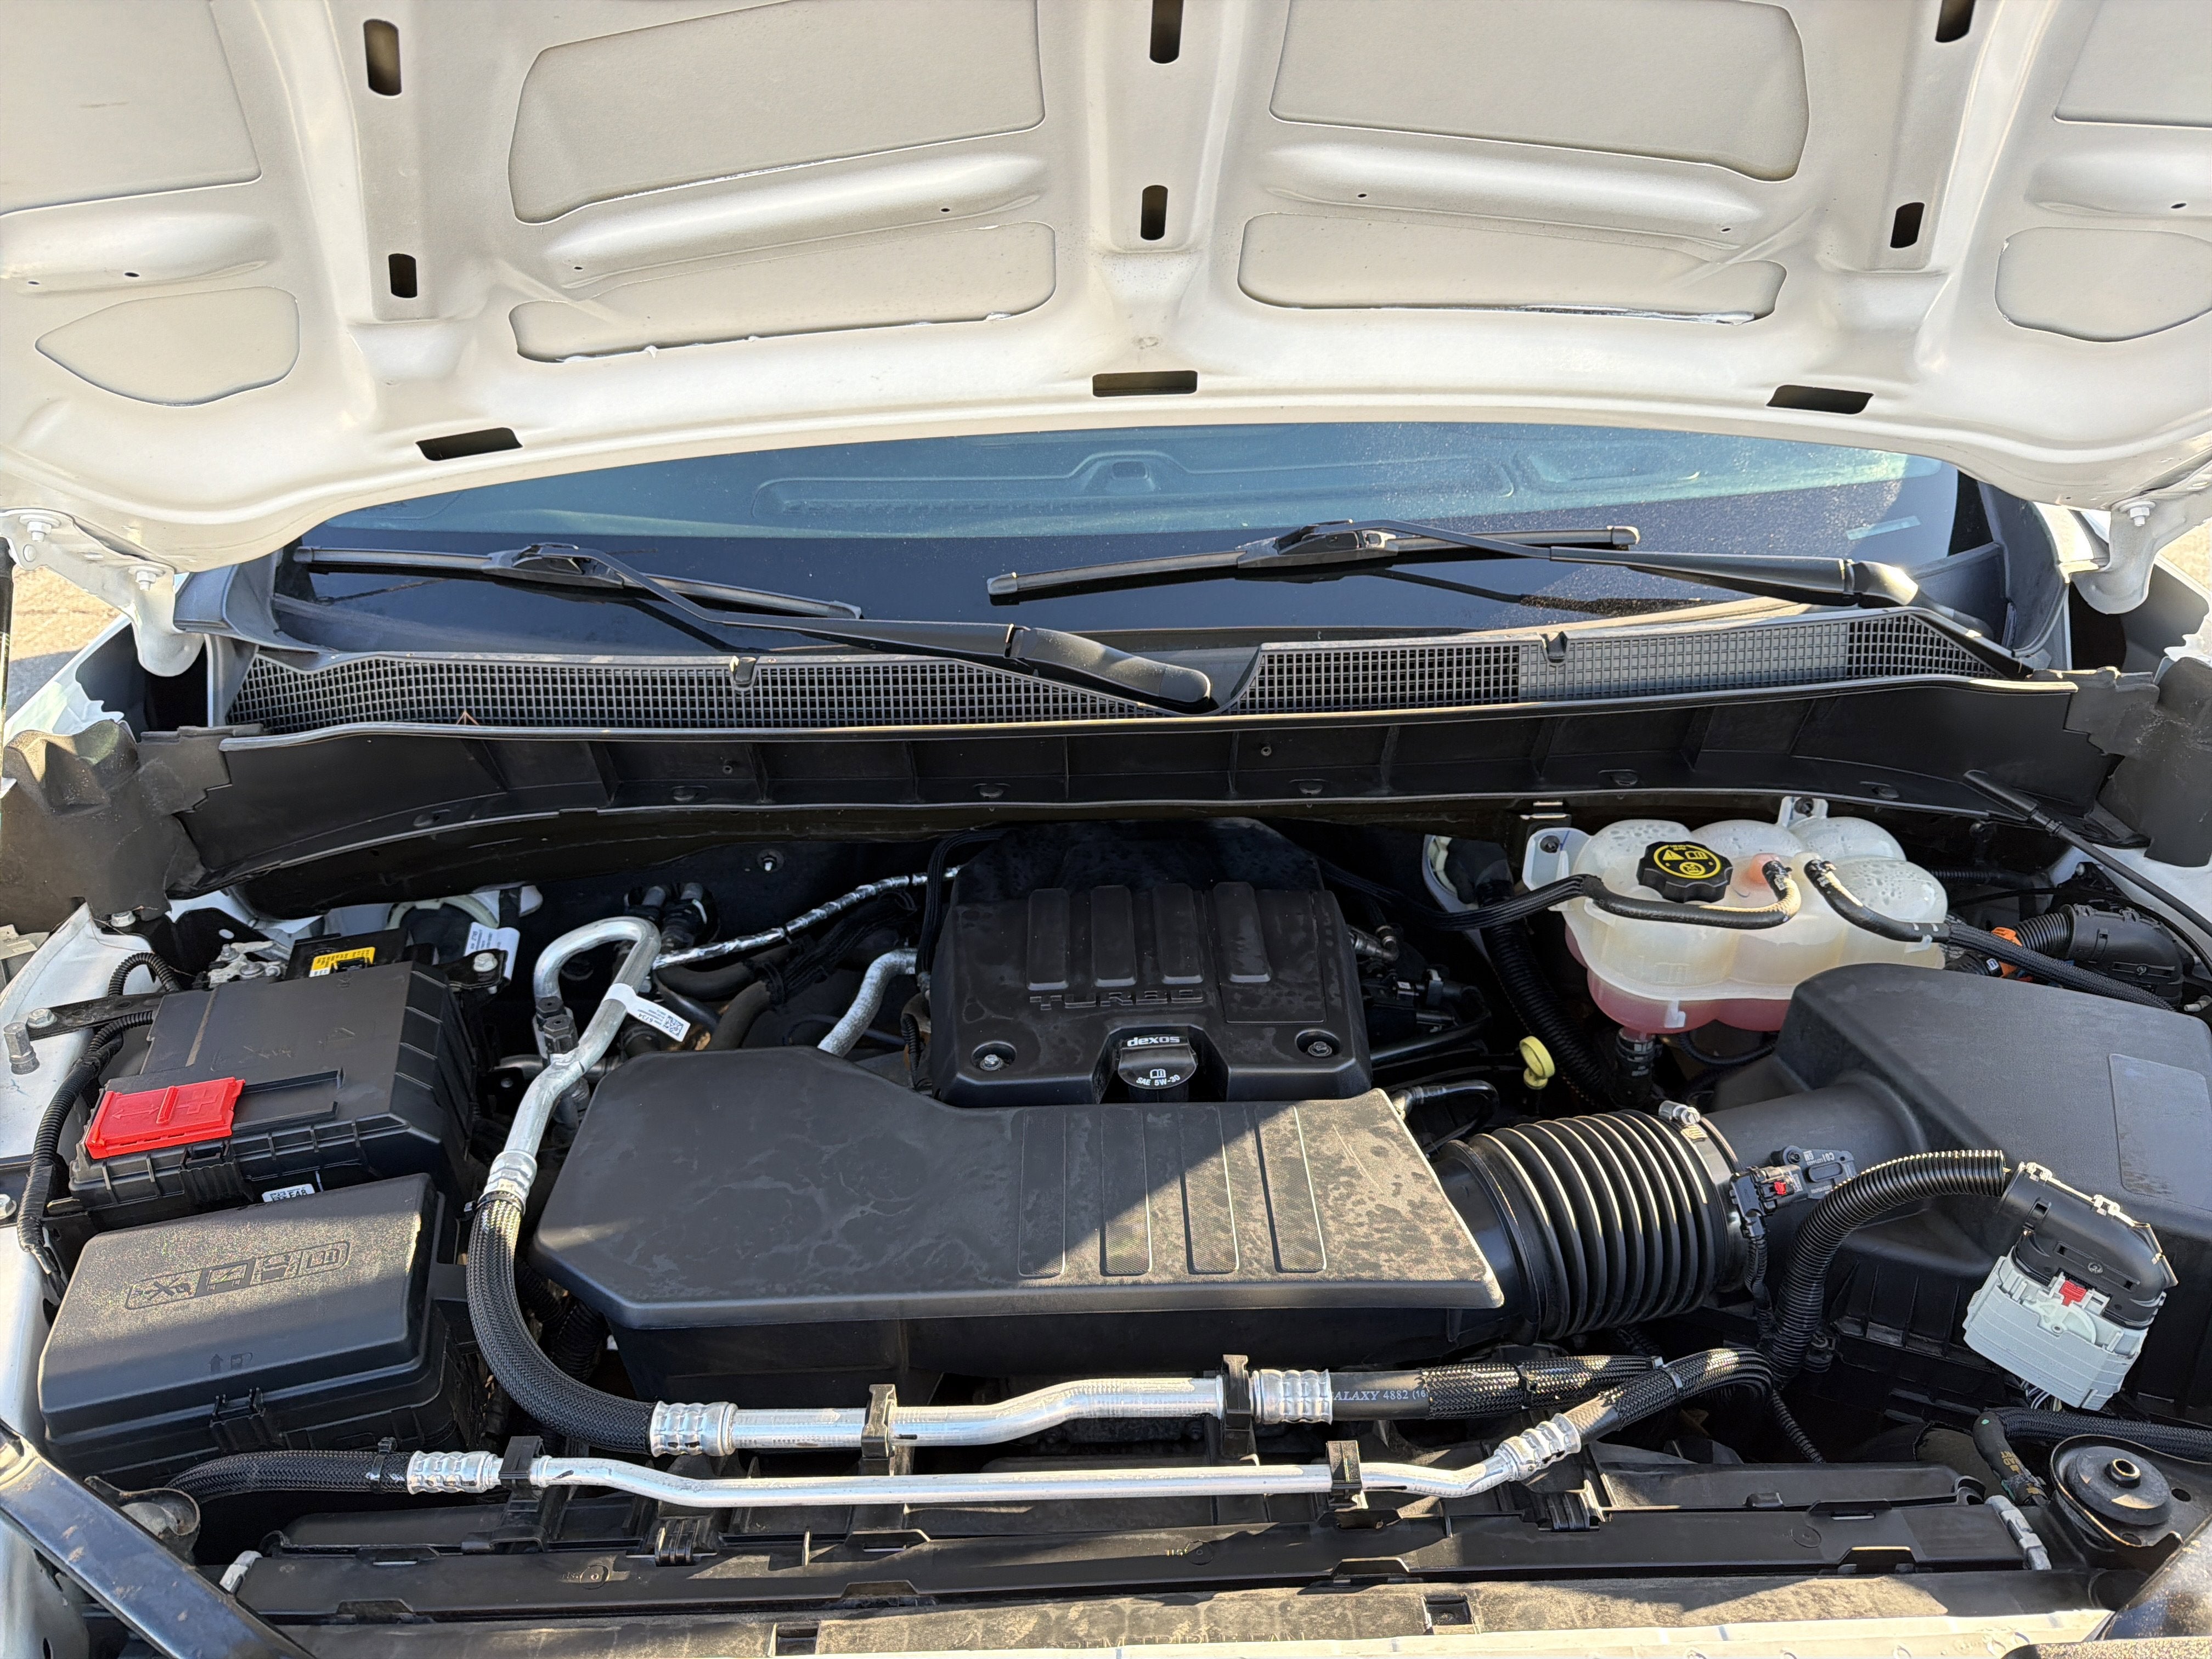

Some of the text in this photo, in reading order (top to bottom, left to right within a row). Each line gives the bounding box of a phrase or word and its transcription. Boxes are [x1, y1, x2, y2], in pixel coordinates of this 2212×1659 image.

[1030, 989, 1203, 1010] TURBO
[1127, 1036, 1180, 1047] dexos
[1136, 1074, 1181, 1086] SAE 5W-30
[1803, 1150, 1814, 1161] GM
[1333, 1391, 1380, 1401] ALAXY
[1383, 1390, 1408, 1400] 4882
